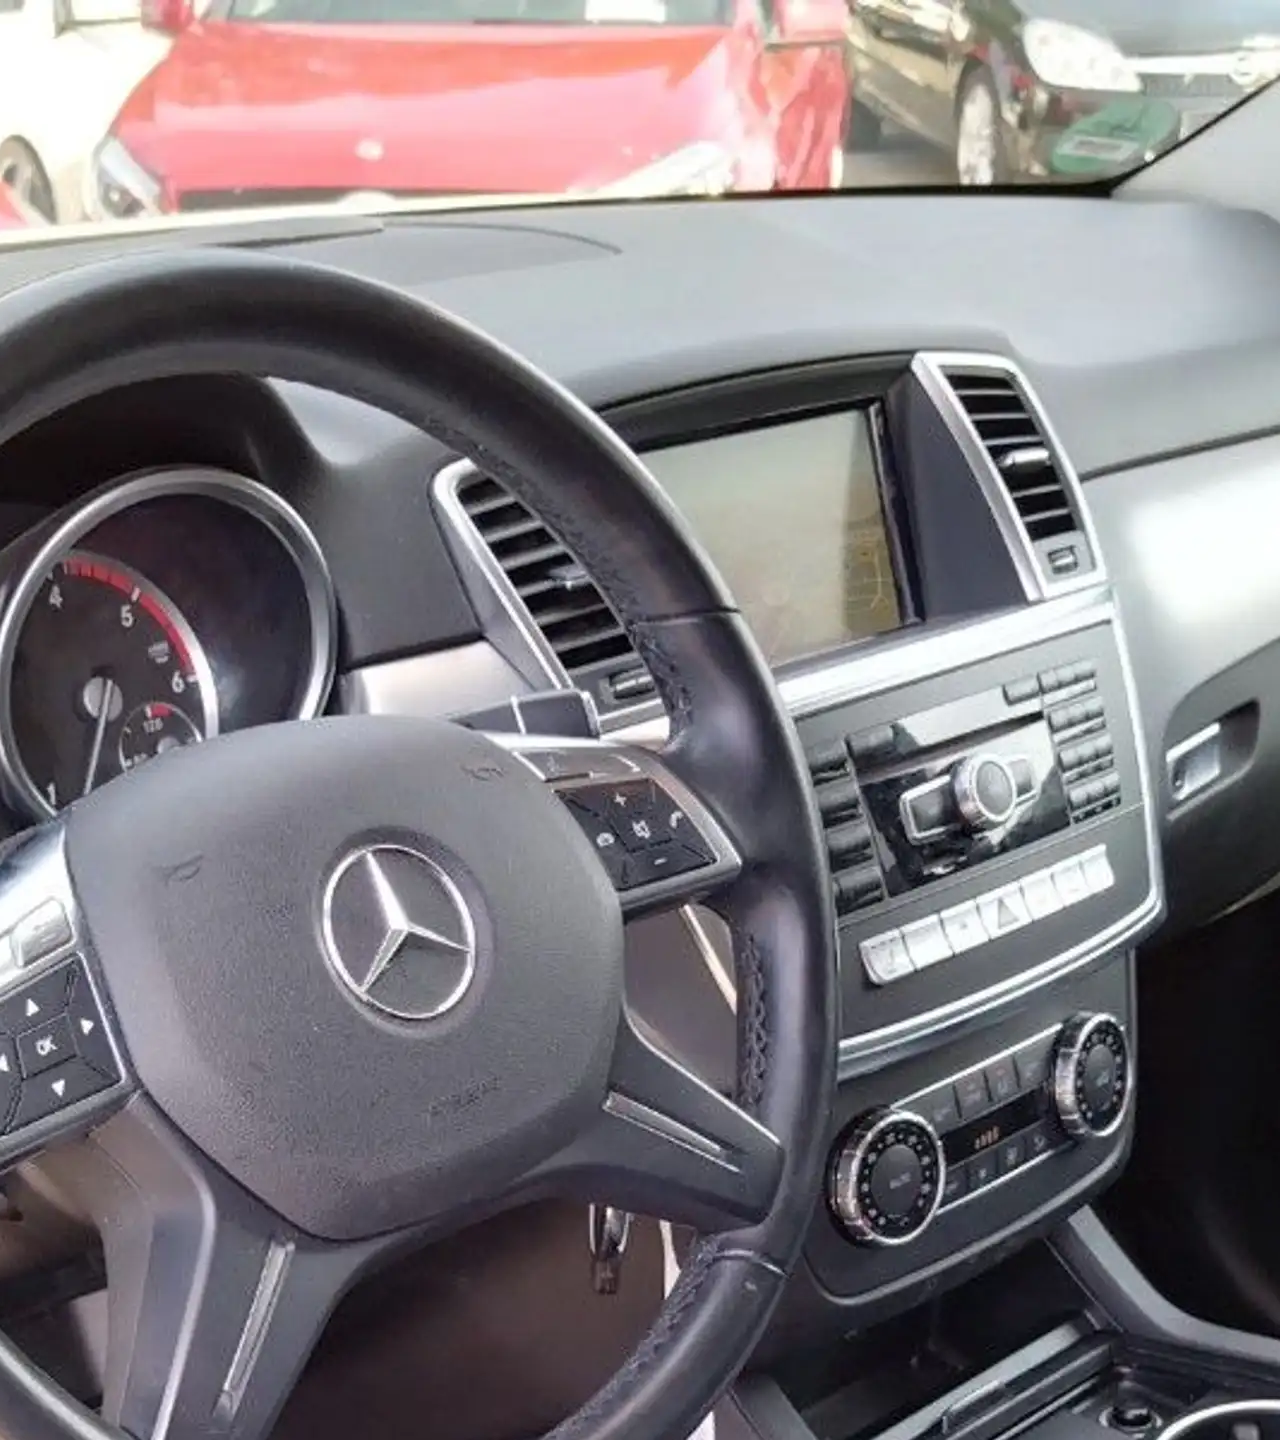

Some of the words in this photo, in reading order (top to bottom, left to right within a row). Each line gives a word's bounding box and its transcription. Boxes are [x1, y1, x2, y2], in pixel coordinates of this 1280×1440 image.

[49, 584, 63, 609] 4
[121, 604, 135, 627] 5
[172, 671, 185, 693] 6
[35, 1035, 58, 1056] OK
